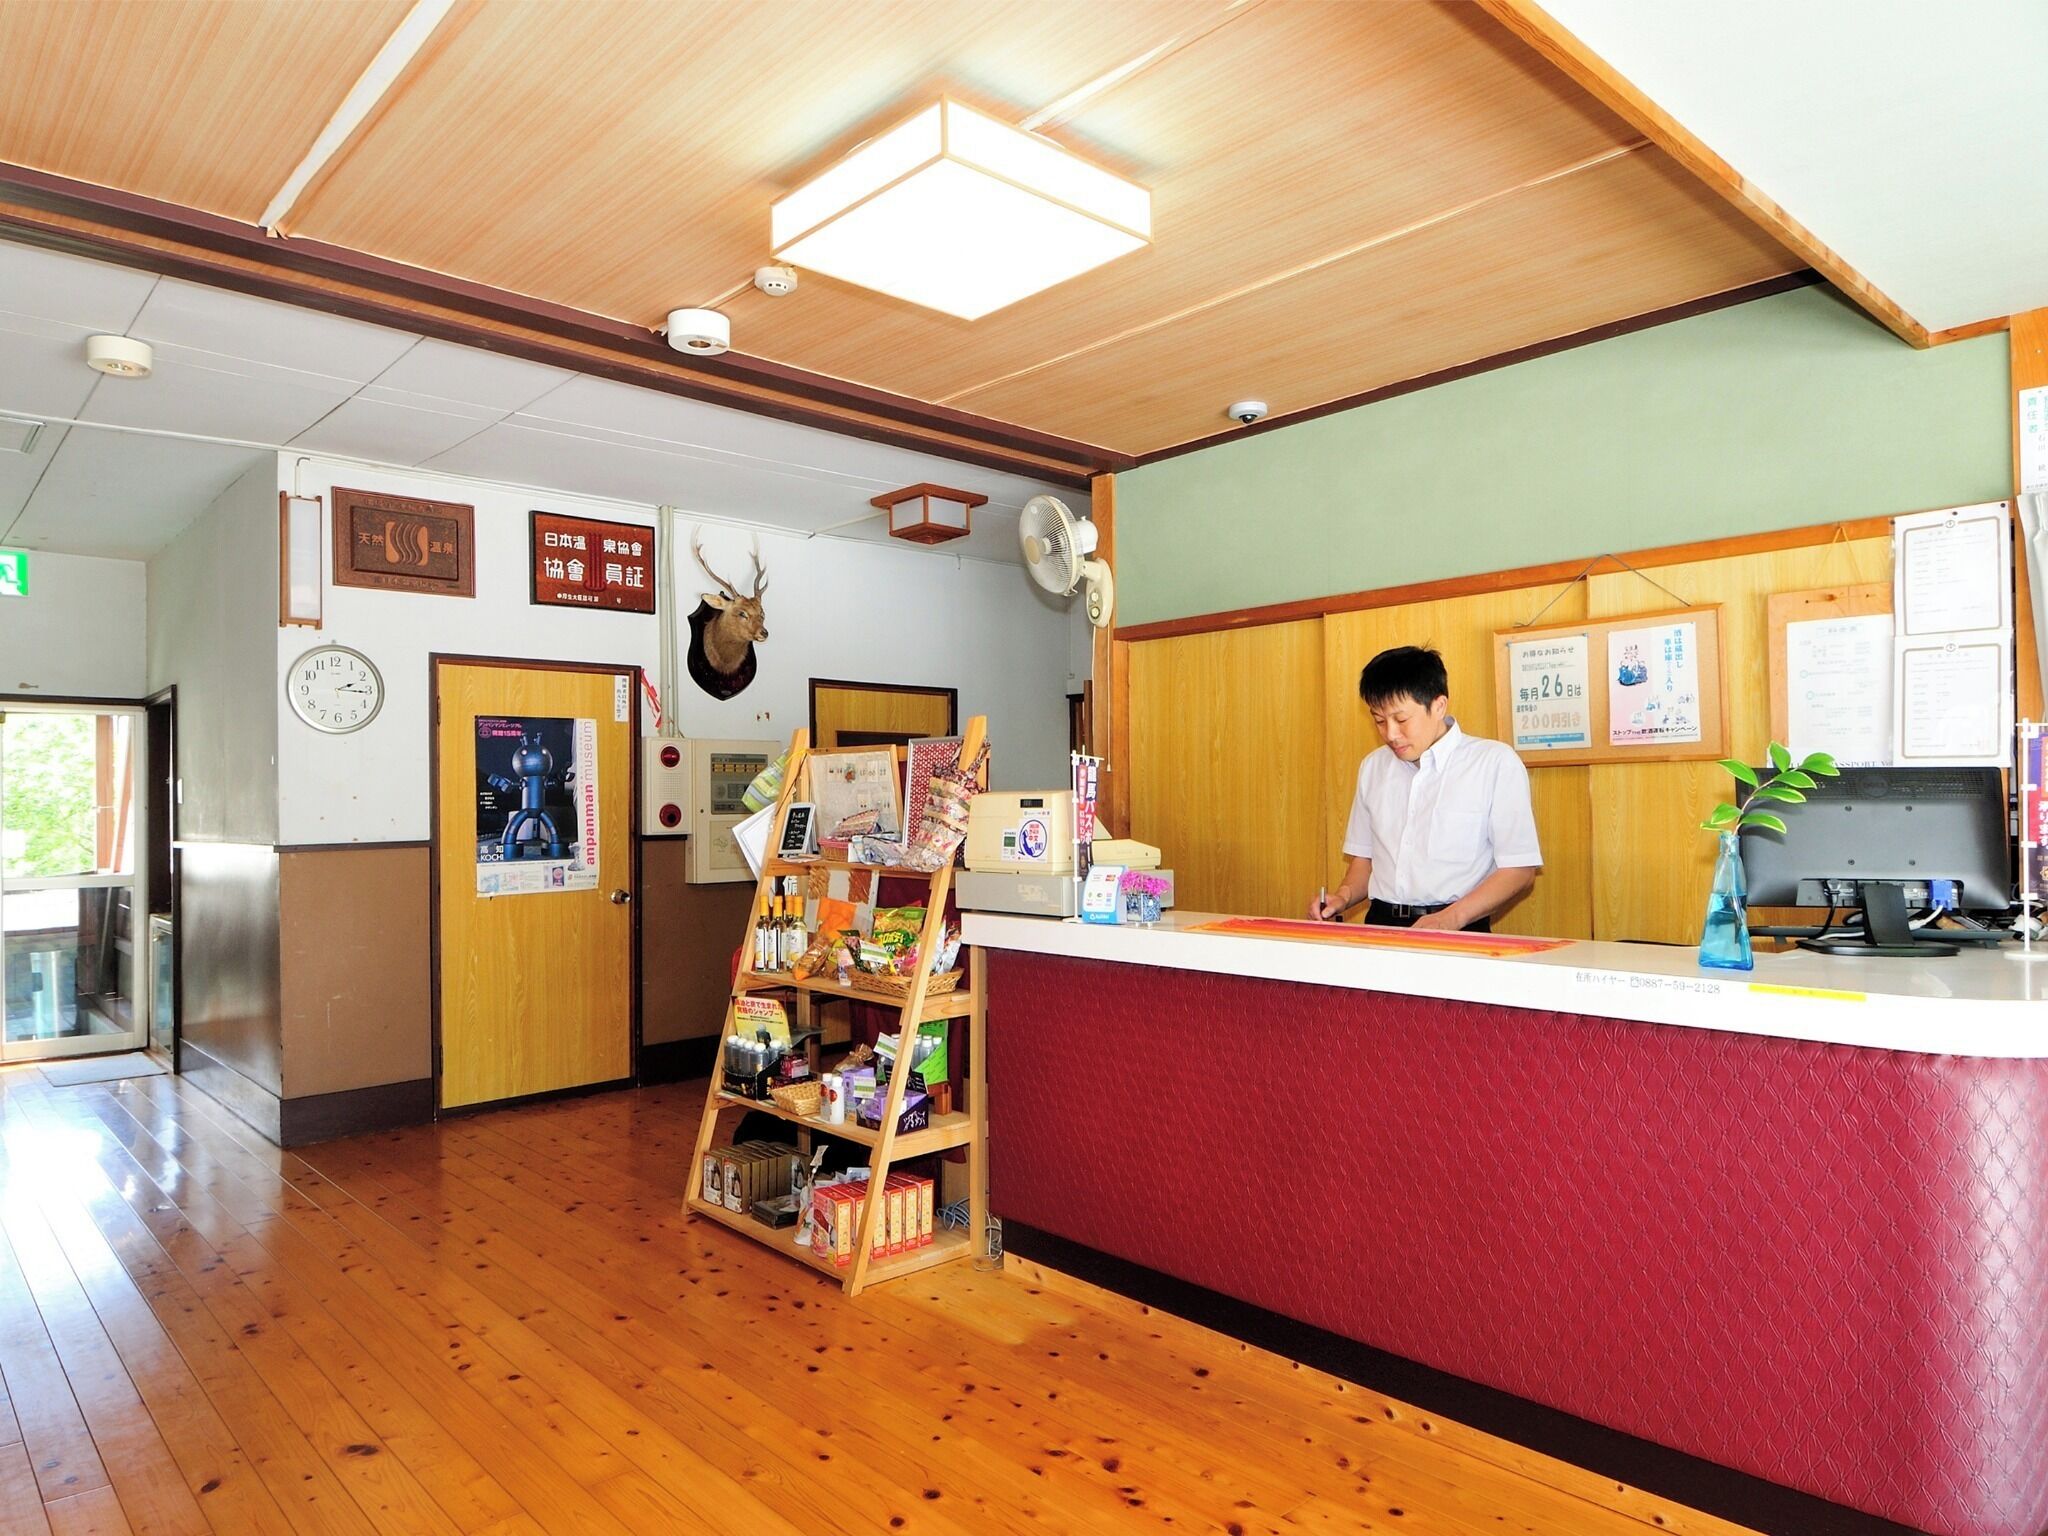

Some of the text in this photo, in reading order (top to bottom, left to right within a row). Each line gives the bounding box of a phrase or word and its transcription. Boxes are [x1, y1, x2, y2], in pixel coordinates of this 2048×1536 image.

[358, 532, 454, 555] 天然 温泉
[545, 532, 643, 557] 日本温 泉協會
[543, 557, 644, 588] 協會 員証
[316, 660, 325, 671] 11
[330, 656, 341, 667] 12
[305, 670, 316, 681] 10
[360, 671, 367, 681] 2
[301, 685, 309, 696] 9
[365, 685, 373, 695] 3
[1520, 673, 1582, 701] 毎月26日は
[308, 700, 316, 709] 8
[320, 709, 327, 720] 7
[334, 713, 343, 723] 6
[350, 710, 358, 720] 5
[583, 721, 597, 865] anpanman museum
[480, 854, 504, 862] KOCHI
